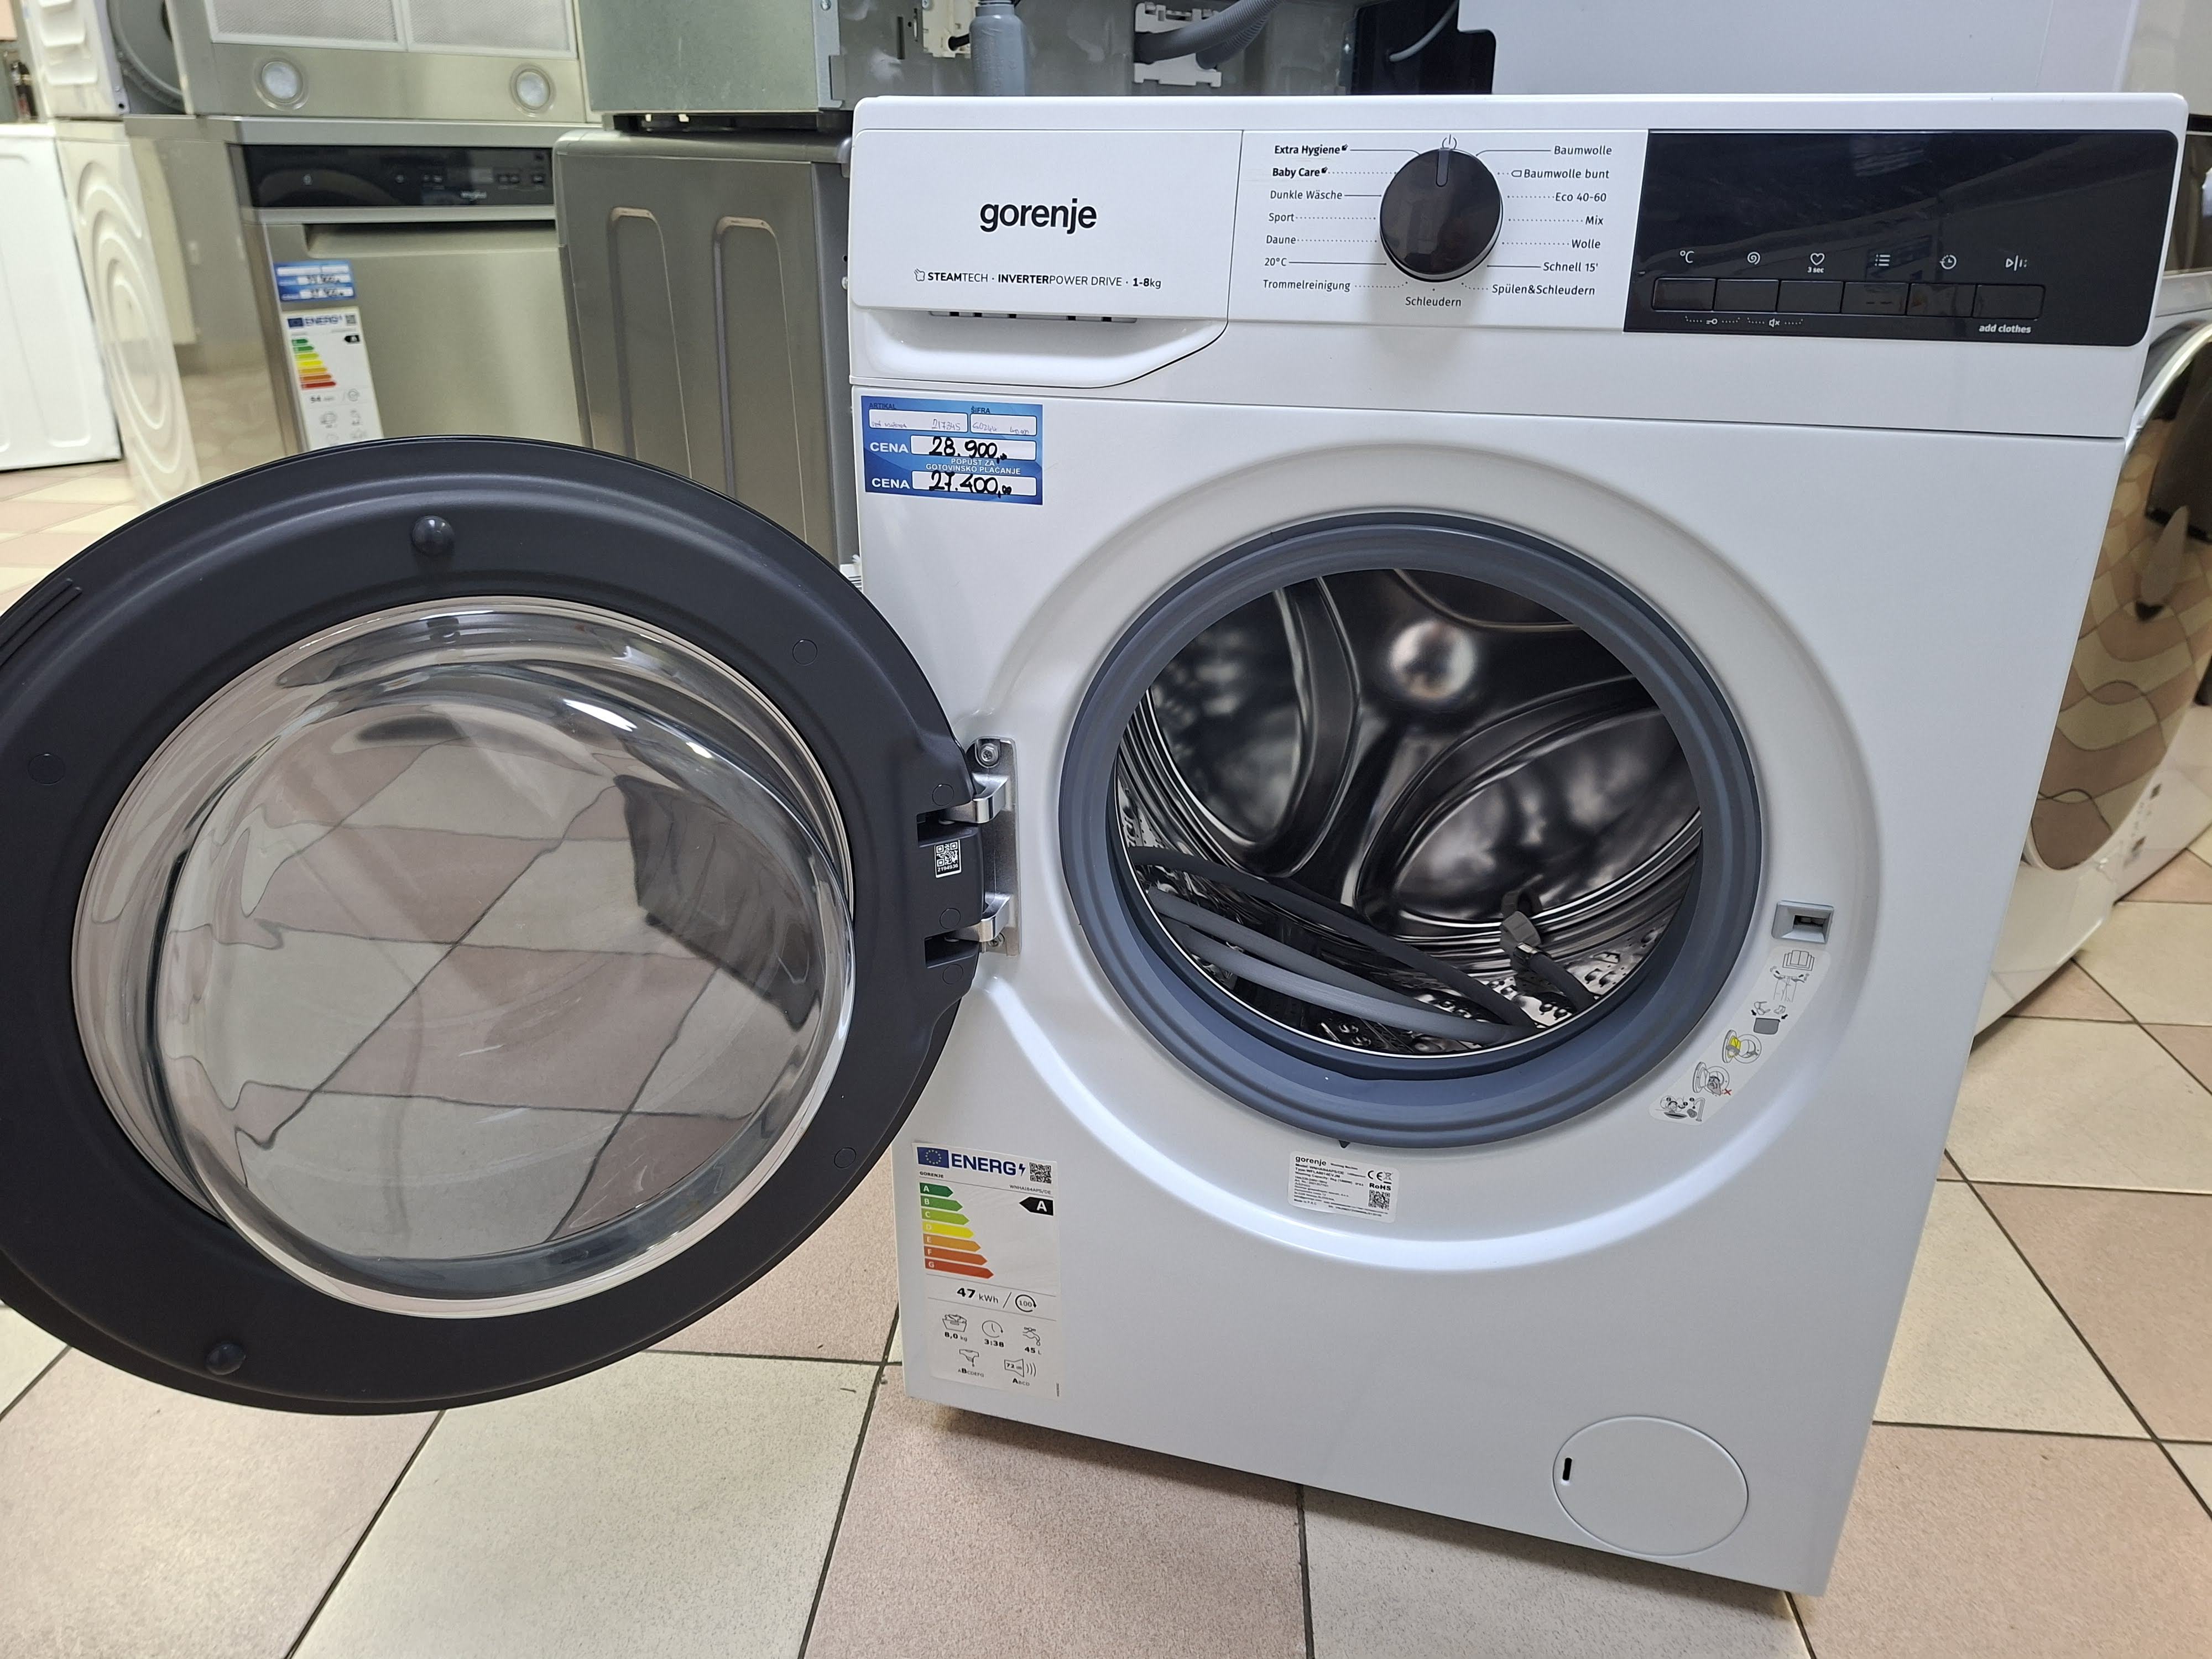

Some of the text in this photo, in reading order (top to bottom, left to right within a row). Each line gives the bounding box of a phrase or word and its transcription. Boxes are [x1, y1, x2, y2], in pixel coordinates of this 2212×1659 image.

[1274, 145, 1341, 156] Extra Hygiene
[1554, 145, 1612, 156] Baumwolle
[1272, 167, 1320, 178] Baby Care
[1524, 169, 1610, 180] Baumwolle bunt
[1270, 190, 1343, 200] Dunkle Wäsche
[1556, 192, 1607, 202] Eco 40-60
[980, 198, 1097, 234] gorenje
[1268, 212, 1295, 223] Sport
[1585, 216, 1604, 226] Mix
[1266, 235, 1296, 244] Daune
[1571, 238, 1601, 249] Wolle
[1264, 257, 1287, 267] 20°C
[1543, 262, 1598, 272] Schnell 15'
[927, 272, 1162, 289] STEAMTECH INVERTERPOWER DRIVE 1-8kg
[1263, 280, 1351, 293] Trommelreinigung
[1492, 284, 1595, 296] Spülen&Schleudern
[1405, 296, 1462, 307] Schleudern
[1979, 324, 2031, 333] add clothes
[870, 442, 909, 453] CENA
[926, 463, 977, 472] GOTOVINSKO
[872, 477, 911, 489] CENA
[951, 1153, 1016, 1176] ENERG
[1295, 1156, 1327, 1166] gorenje
[1369, 1182, 1391, 1191] RoHS
[1036, 1200, 1047, 1212] A
[957, 1287, 999, 1303] 47 kWh
[984, 1339, 1004, 1348] 3:38
[1013, 1378, 1030, 1386] ABCD
